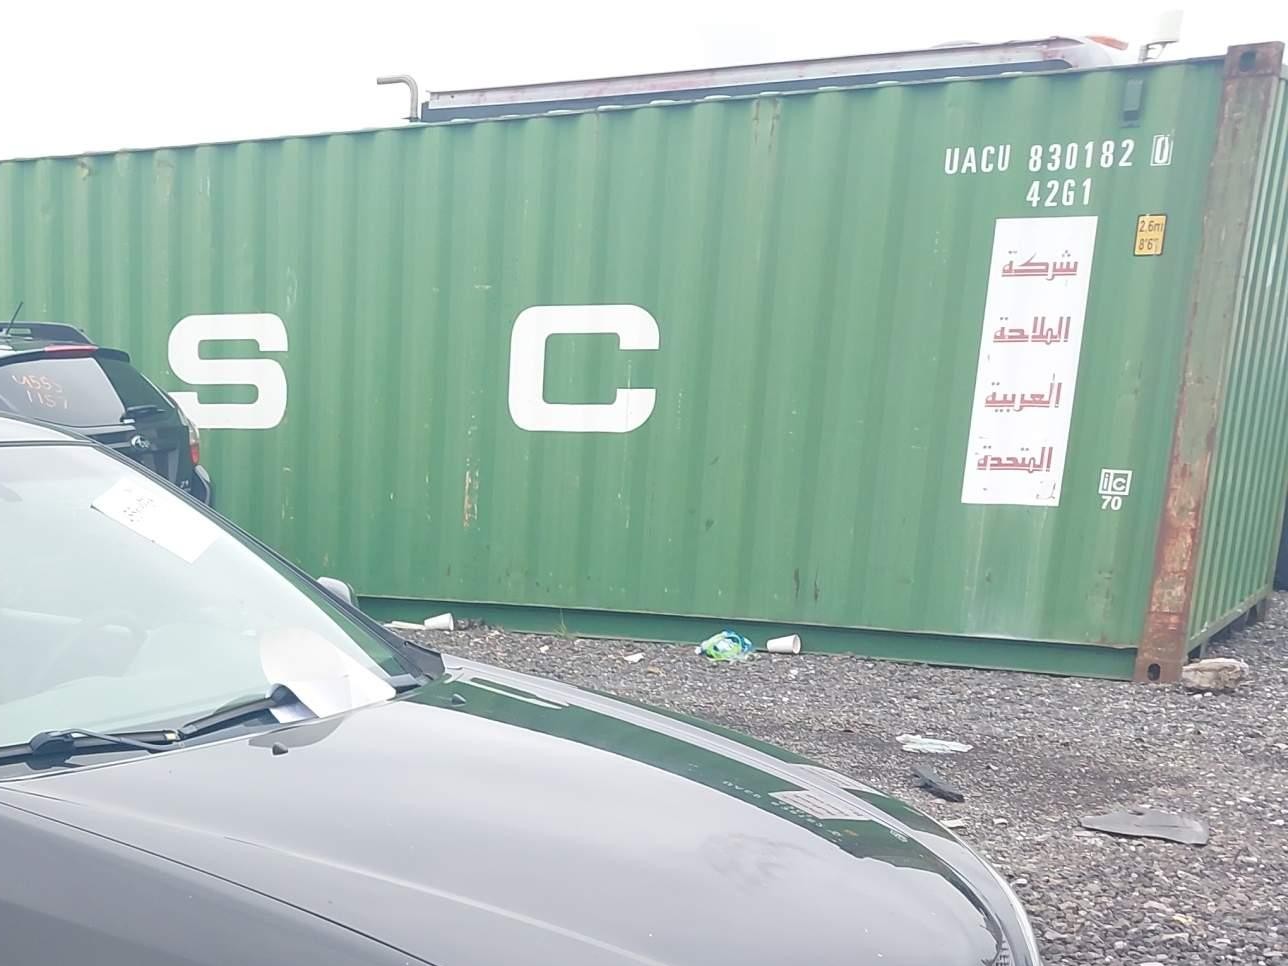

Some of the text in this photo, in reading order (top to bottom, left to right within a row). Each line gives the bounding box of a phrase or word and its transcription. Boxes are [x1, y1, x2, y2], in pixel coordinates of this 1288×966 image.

[944, 144, 1011, 175] UACU
[1028, 138, 1135, 172] 830182
[1026, 178, 1092, 207] 42G1
[1001, 249, 1078, 281] شركة
[993, 315, 1071, 345] الملاحة
[984, 382, 1063, 412] العربية
[976, 445, 1054, 474] المتحدة
[1101, 495, 1122, 511] 70
